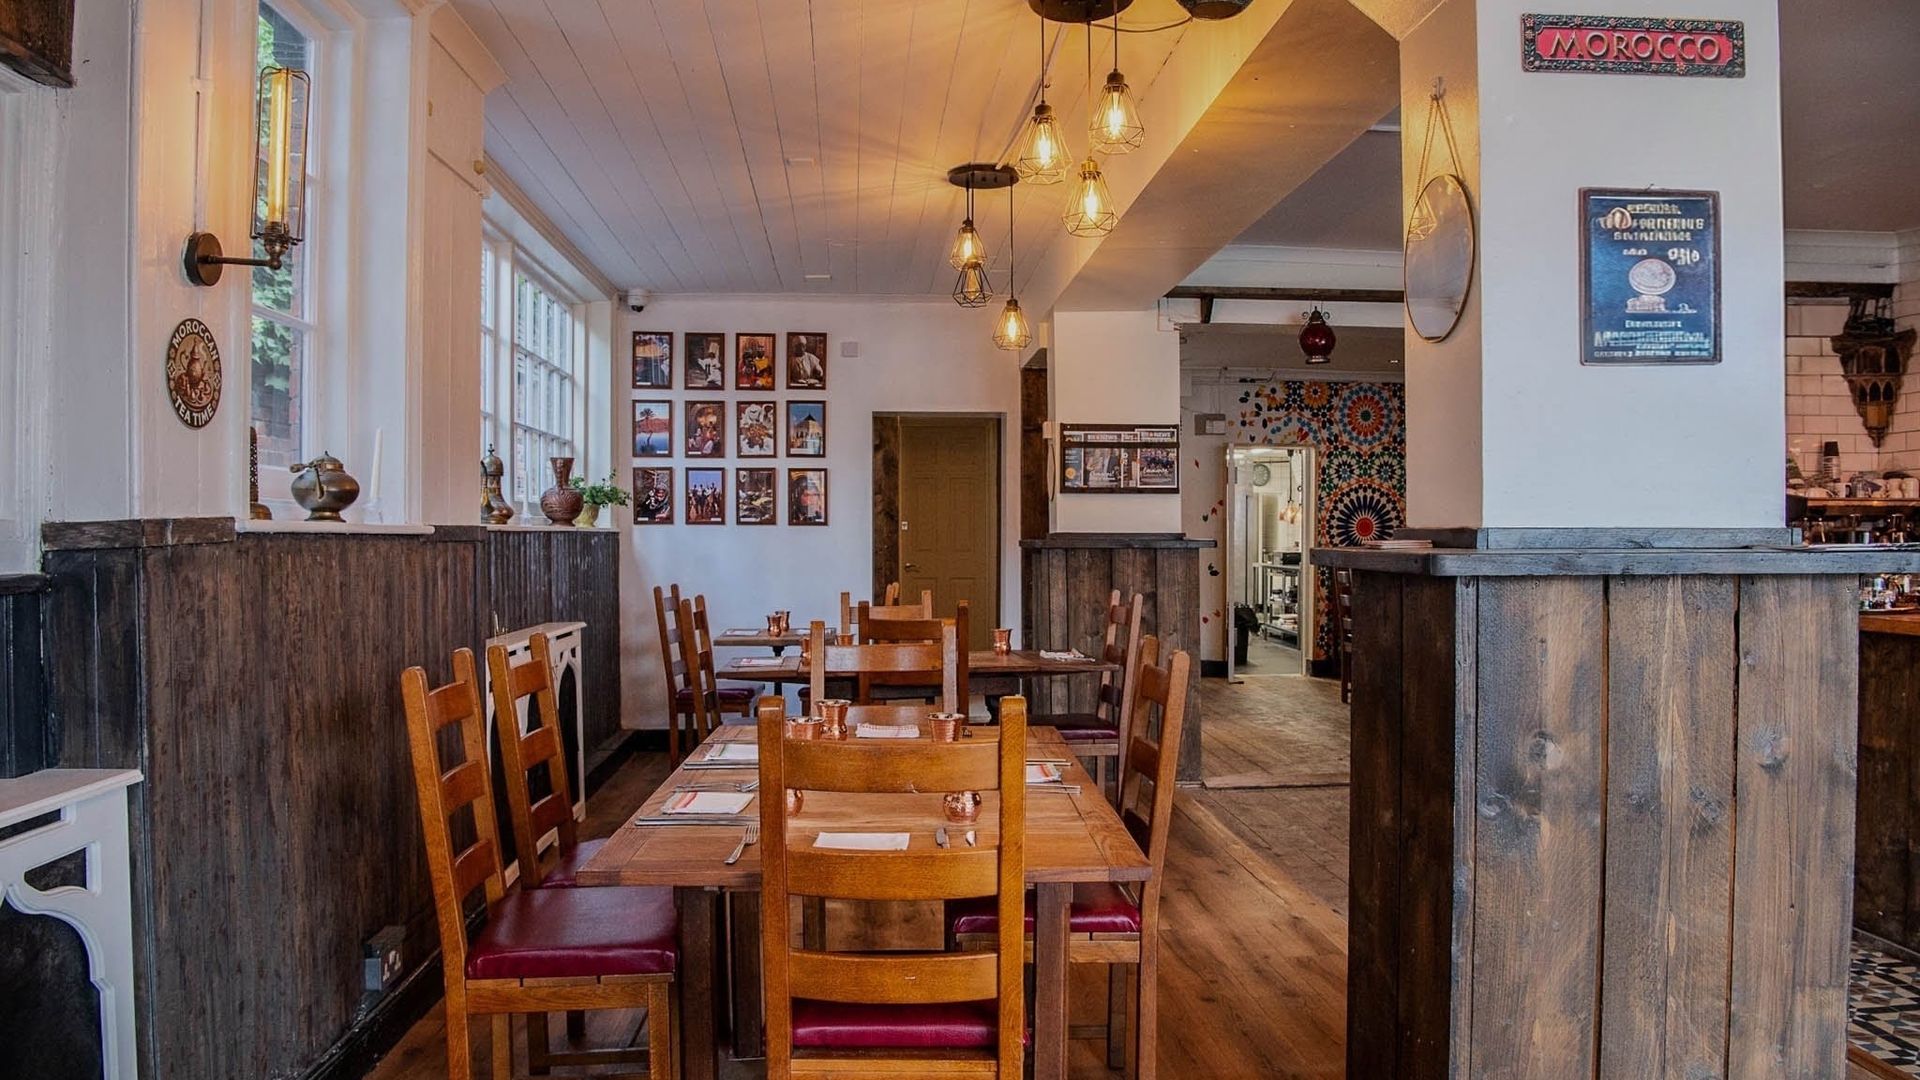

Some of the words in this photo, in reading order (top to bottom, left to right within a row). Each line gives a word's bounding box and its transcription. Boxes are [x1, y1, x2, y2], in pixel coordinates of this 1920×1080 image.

[1550, 31, 1721, 61] MOROCCO
[172, 320, 219, 360] MOROCCAN
[174, 395, 192, 424] TEA
[192, 403, 214, 426] TIME
